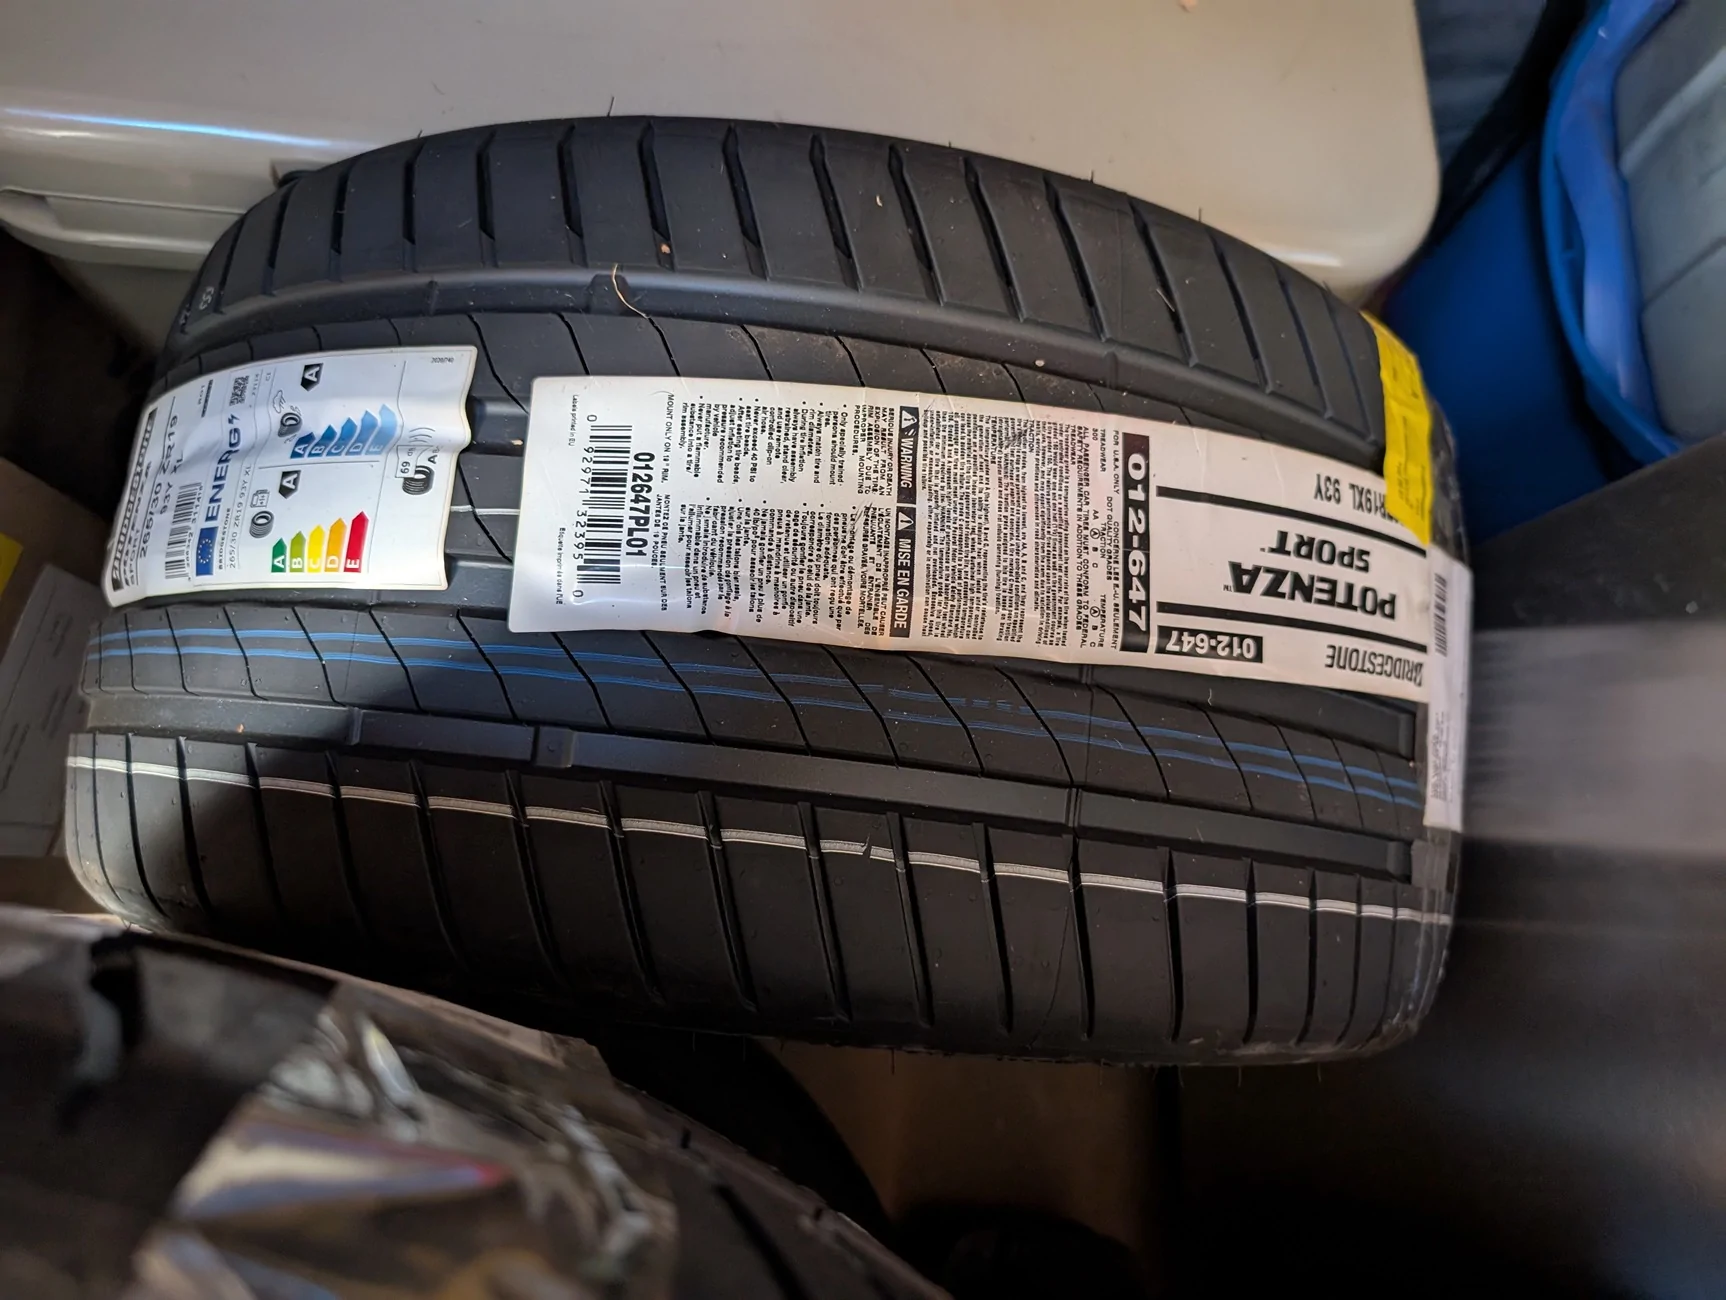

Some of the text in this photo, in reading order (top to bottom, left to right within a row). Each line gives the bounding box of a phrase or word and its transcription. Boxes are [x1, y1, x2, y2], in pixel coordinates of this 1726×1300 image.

[304, 366, 320, 382] A
[666, 394, 674, 420] MOUNT
[839, 411, 848, 427] Only
[664, 421, 672, 441] ONLY
[851, 404, 860, 455] PROCEDURES.
[350, 443, 363, 452] D
[370, 444, 384, 452] E
[568, 437, 576, 446] EU
[663, 442, 671, 452] ON
[837, 428, 846, 458] specially
[295, 444, 308, 454] A
[312, 445, 326, 454] B
[332, 445, 343, 454] C
[873, 447, 880, 457] OF
[750, 452, 758, 461] 40
[900, 437, 914, 488] WARNING
[401, 461, 410, 473] 69
[887, 462, 893, 472] OR
[283, 474, 298, 488] A
[661, 468, 669, 483] RIM.
[140, 415, 178, 558] 265/30 ZR19
[160, 454, 184, 515] 93Y XL
[864, 485, 871, 494] TO
[878, 485, 885, 496] AN
[1313, 473, 1340, 504] 93Y
[572, 414, 597, 598] 0 92971 32395 0
[626, 452, 654, 556] 012647PL01
[662, 494, 670, 520] MONTEZ
[229, 466, 252, 569] 265/30 ZR19 93Y XL
[884, 507, 891, 517] UN
[1076, 513, 1082, 522] IN
[1092, 509, 1099, 520] AA
[654, 519, 661, 527] DE
[661, 521, 668, 530] CE
[218, 508, 231, 570] BRIDGESTONE
[1126, 452, 1147, 633] 012-647
[129, 528, 140, 585] SPORT
[1268, 530, 1370, 572] SPORT
[273, 556, 286, 568] A
[292, 558, 303, 568] B
[310, 558, 320, 568] C
[327, 556, 338, 568] D
[347, 559, 360, 569] E
[1076, 560, 1083, 571] TO
[894, 538, 911, 628] MISE EN GARDE
[1226, 562, 1395, 619] POTENZA
[1082, 600, 1089, 610] TO
[1097, 594, 1106, 647] TEMPERATURE
[1110, 602, 1120, 649] SEULEMENT
[1079, 613, 1089, 648] FEDERAL
[1166, 631, 1255, 658] 012-647
[1325, 644, 1423, 686] BRIDGESTONE
